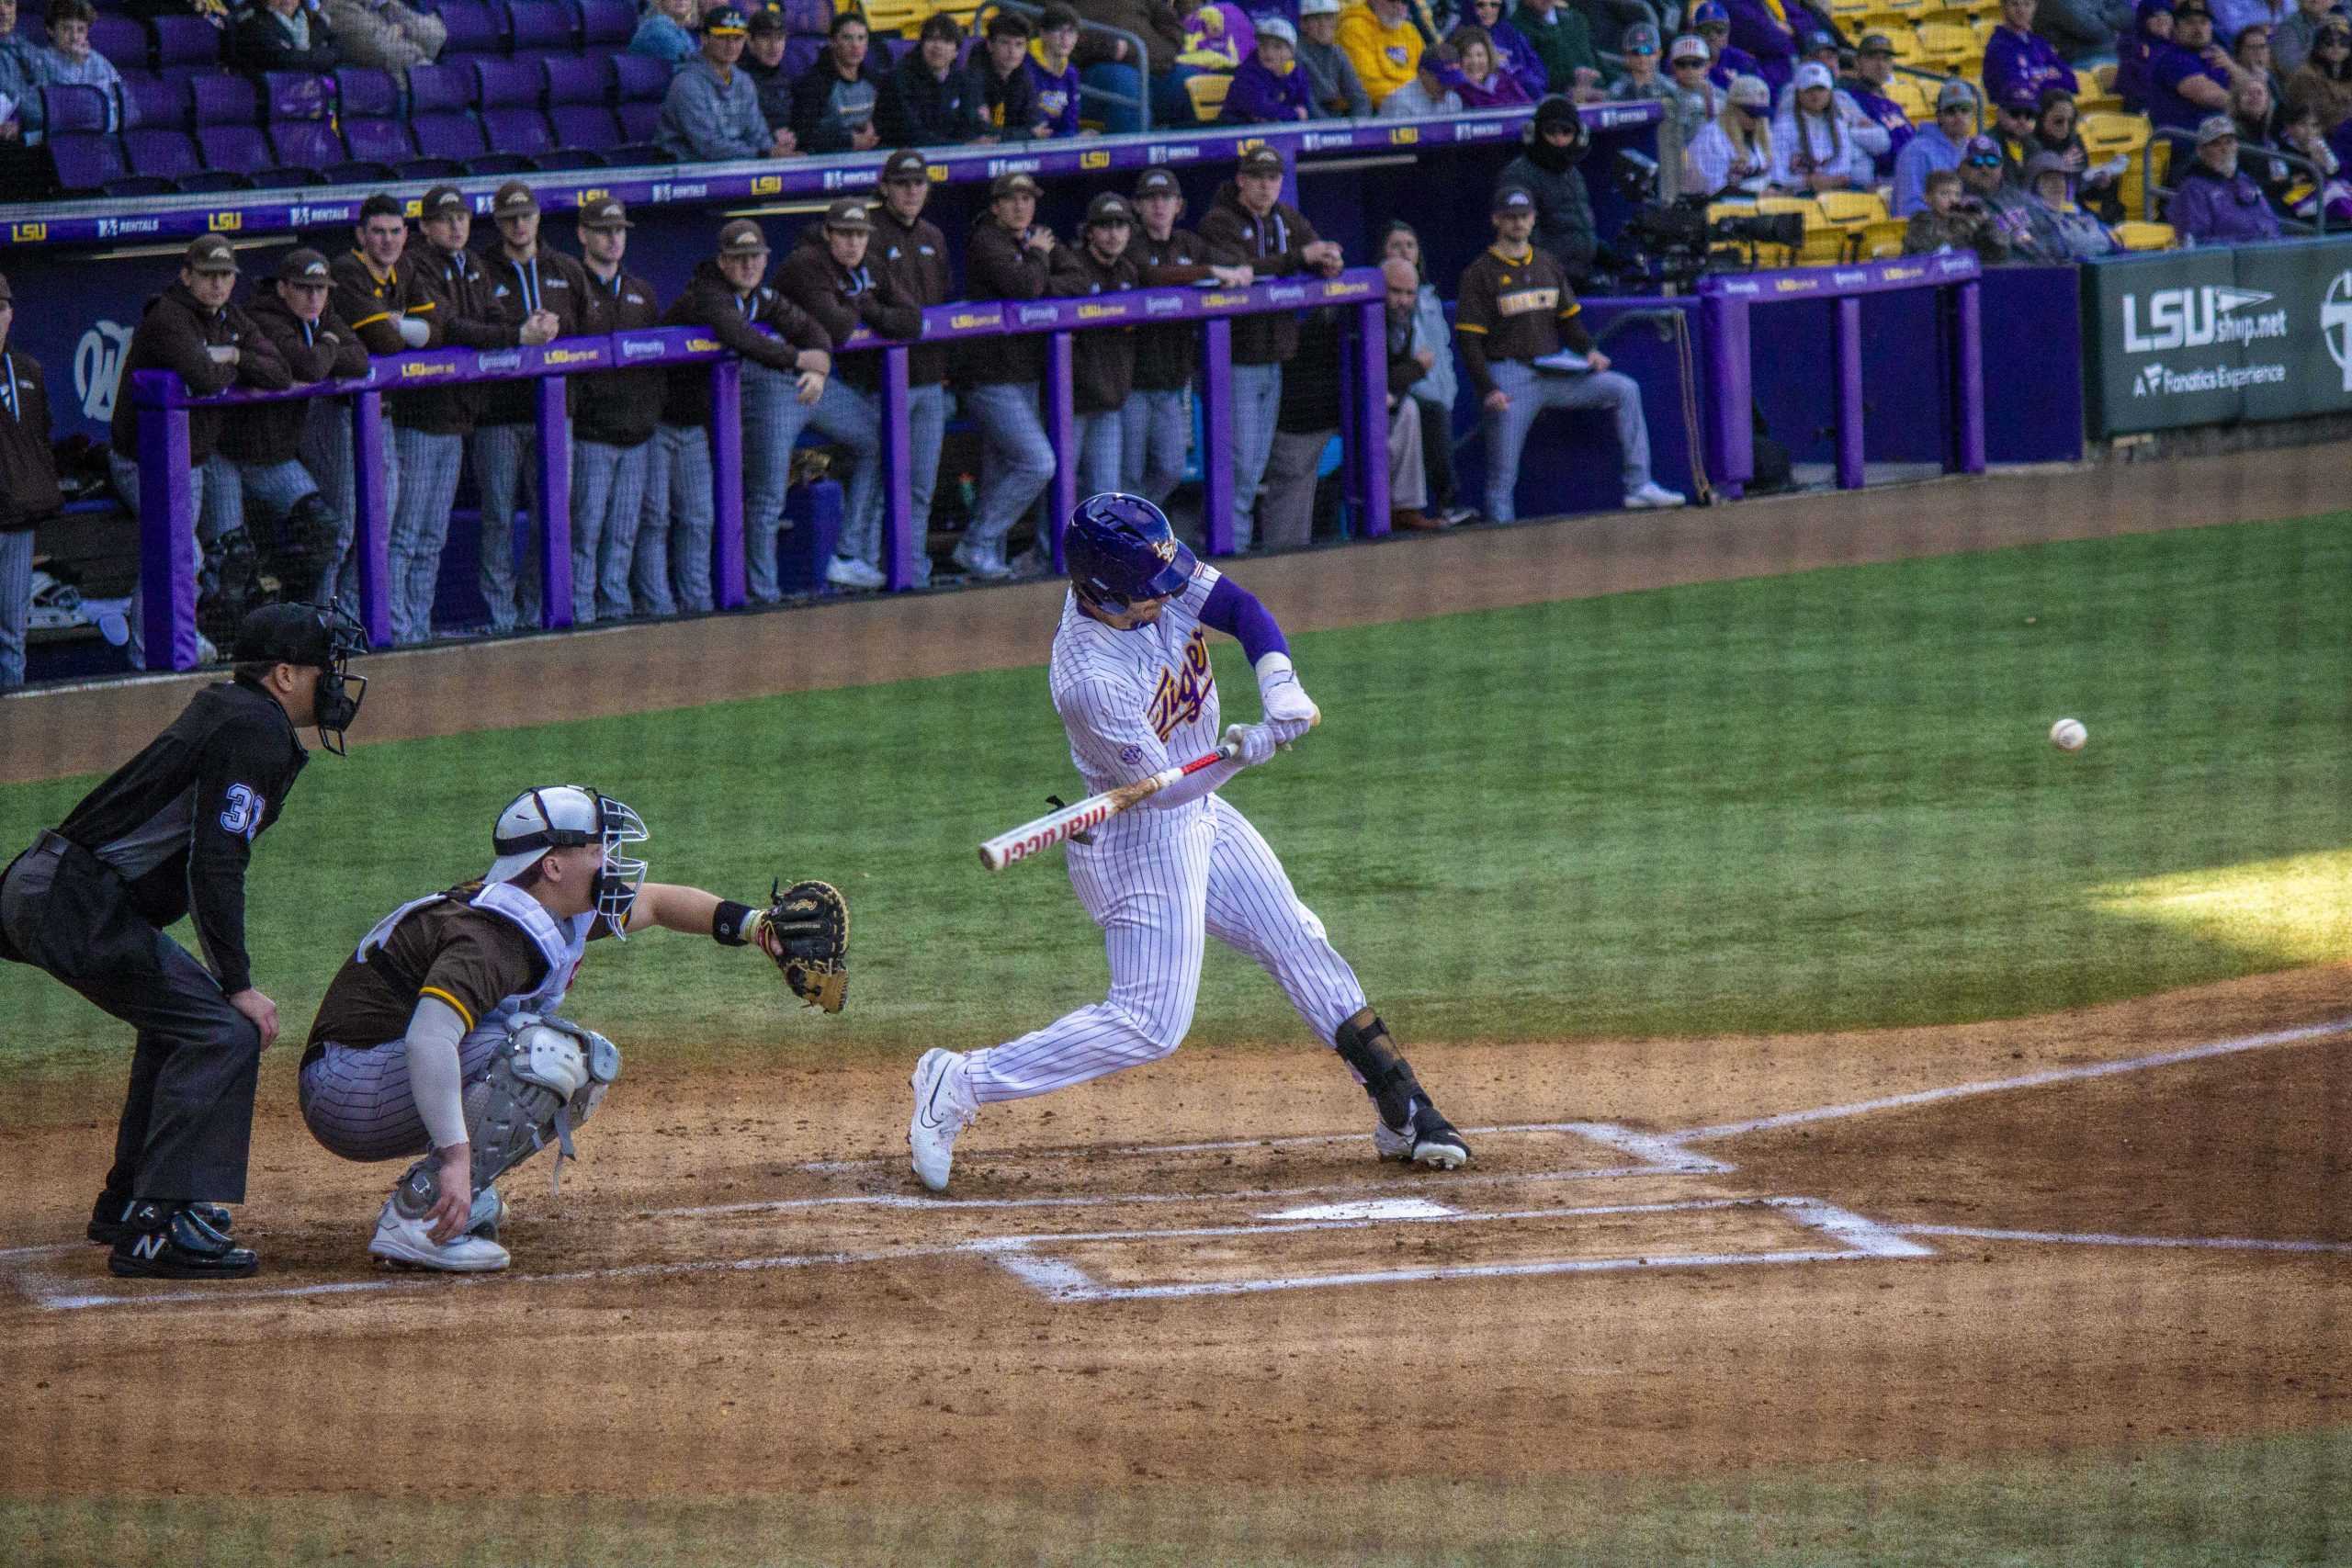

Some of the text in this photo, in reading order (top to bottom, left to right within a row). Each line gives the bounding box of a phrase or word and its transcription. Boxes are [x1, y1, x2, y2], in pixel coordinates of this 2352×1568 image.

[1080, 151, 1110, 169] LSU
[751, 175, 782, 196] LSU
[119, 219, 160, 233] RENTALS
[209, 212, 242, 231] LSU
[11, 223, 46, 243] LSU
[2218, 365, 2286, 391] Experience
[1002, 805, 1106, 865] marucci
